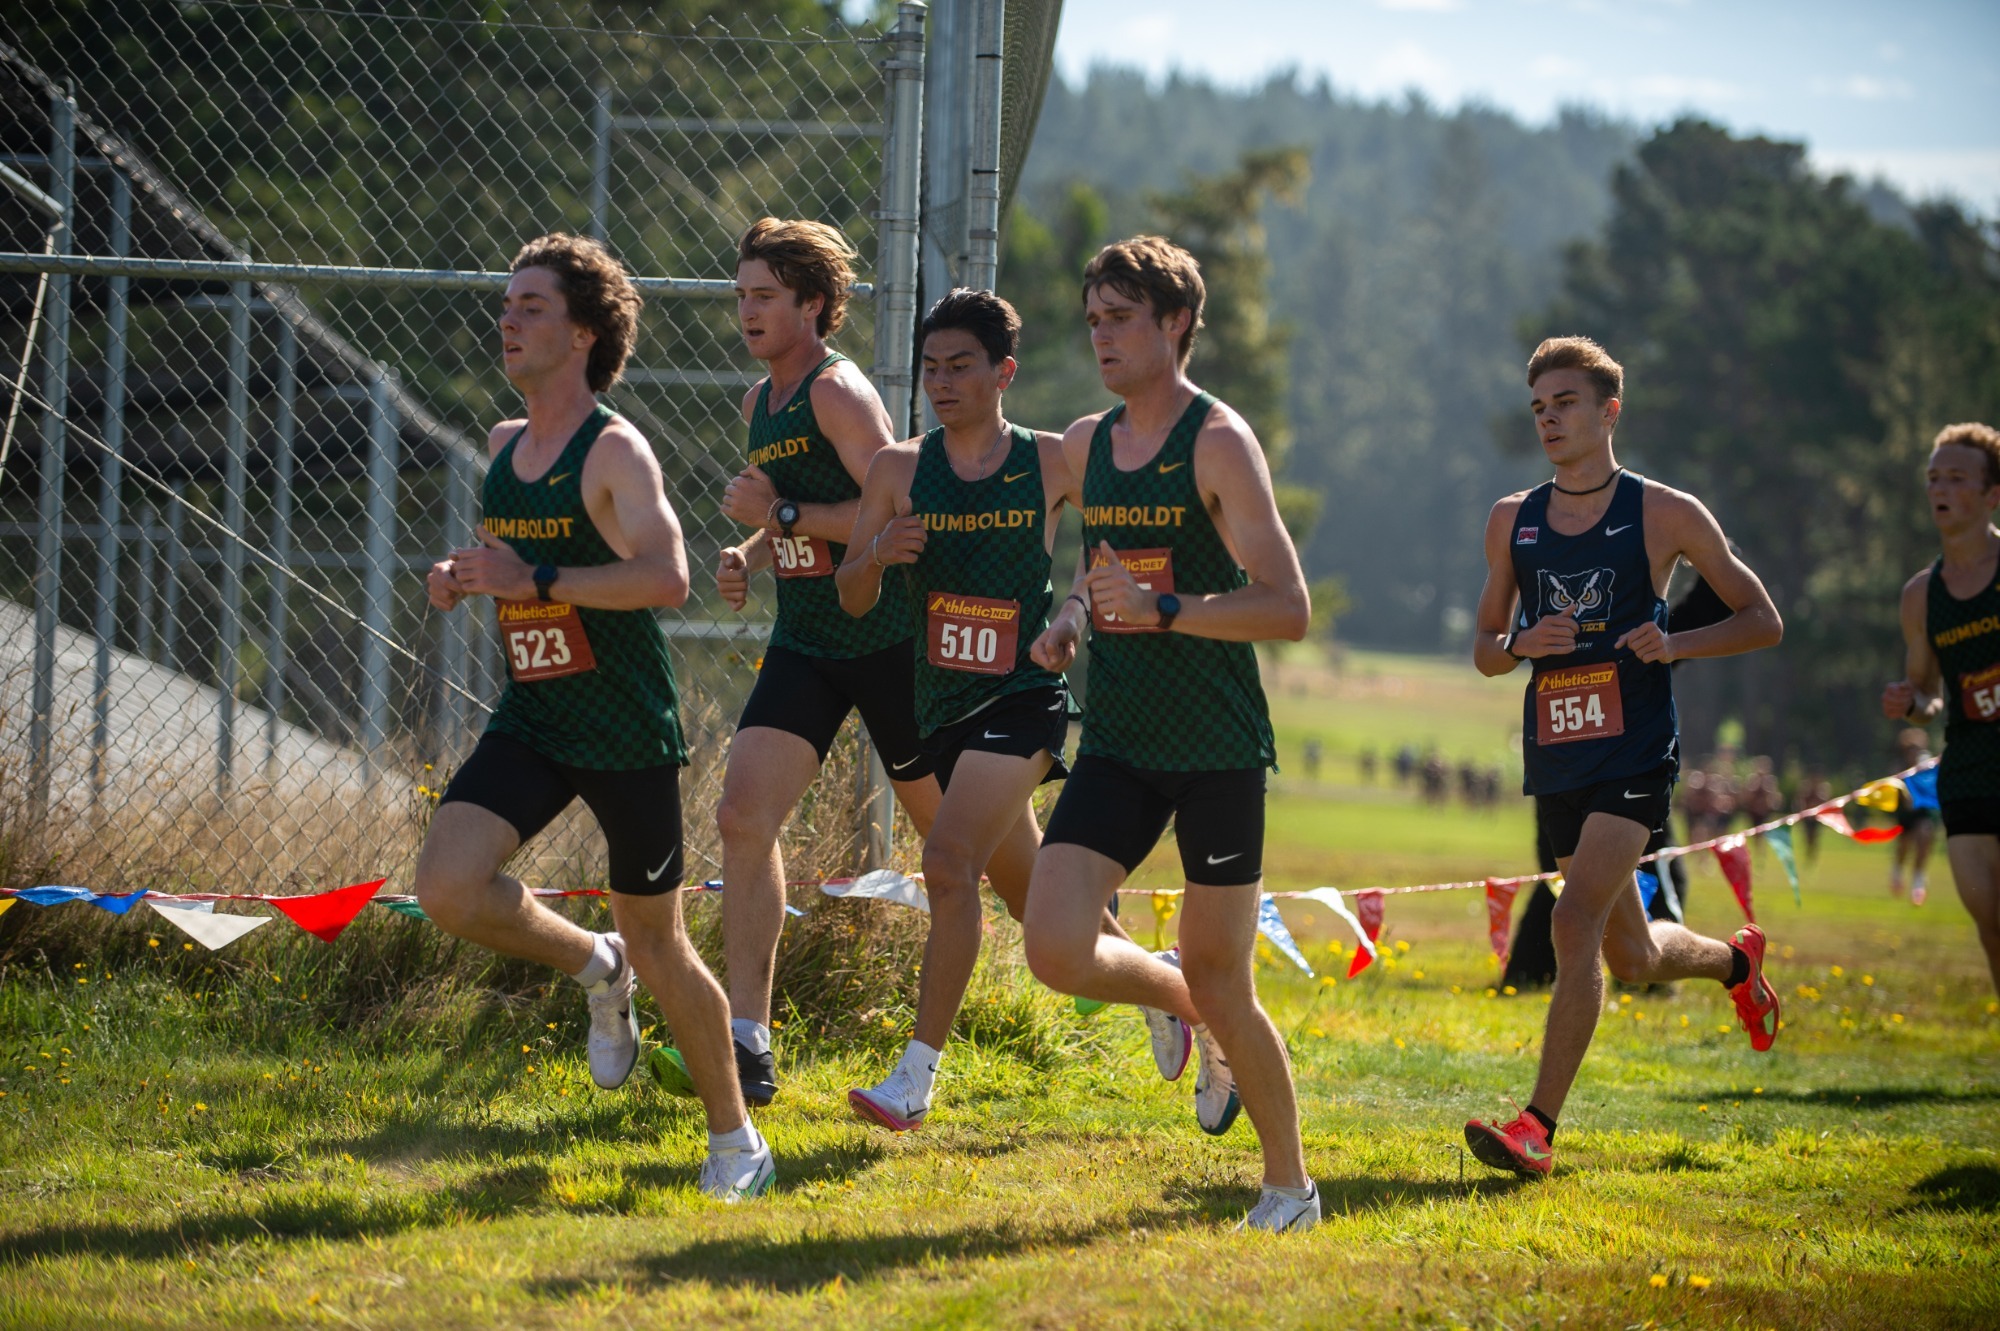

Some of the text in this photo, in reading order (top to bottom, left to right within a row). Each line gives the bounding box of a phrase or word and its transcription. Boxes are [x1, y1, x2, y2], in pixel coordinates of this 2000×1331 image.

[916, 510, 1036, 532] HUMBOLDT
[772, 536, 815, 570] 505
[510, 628, 571, 670] 523
[940, 623, 997, 663] 510
[1549, 694, 1605, 733] 554
